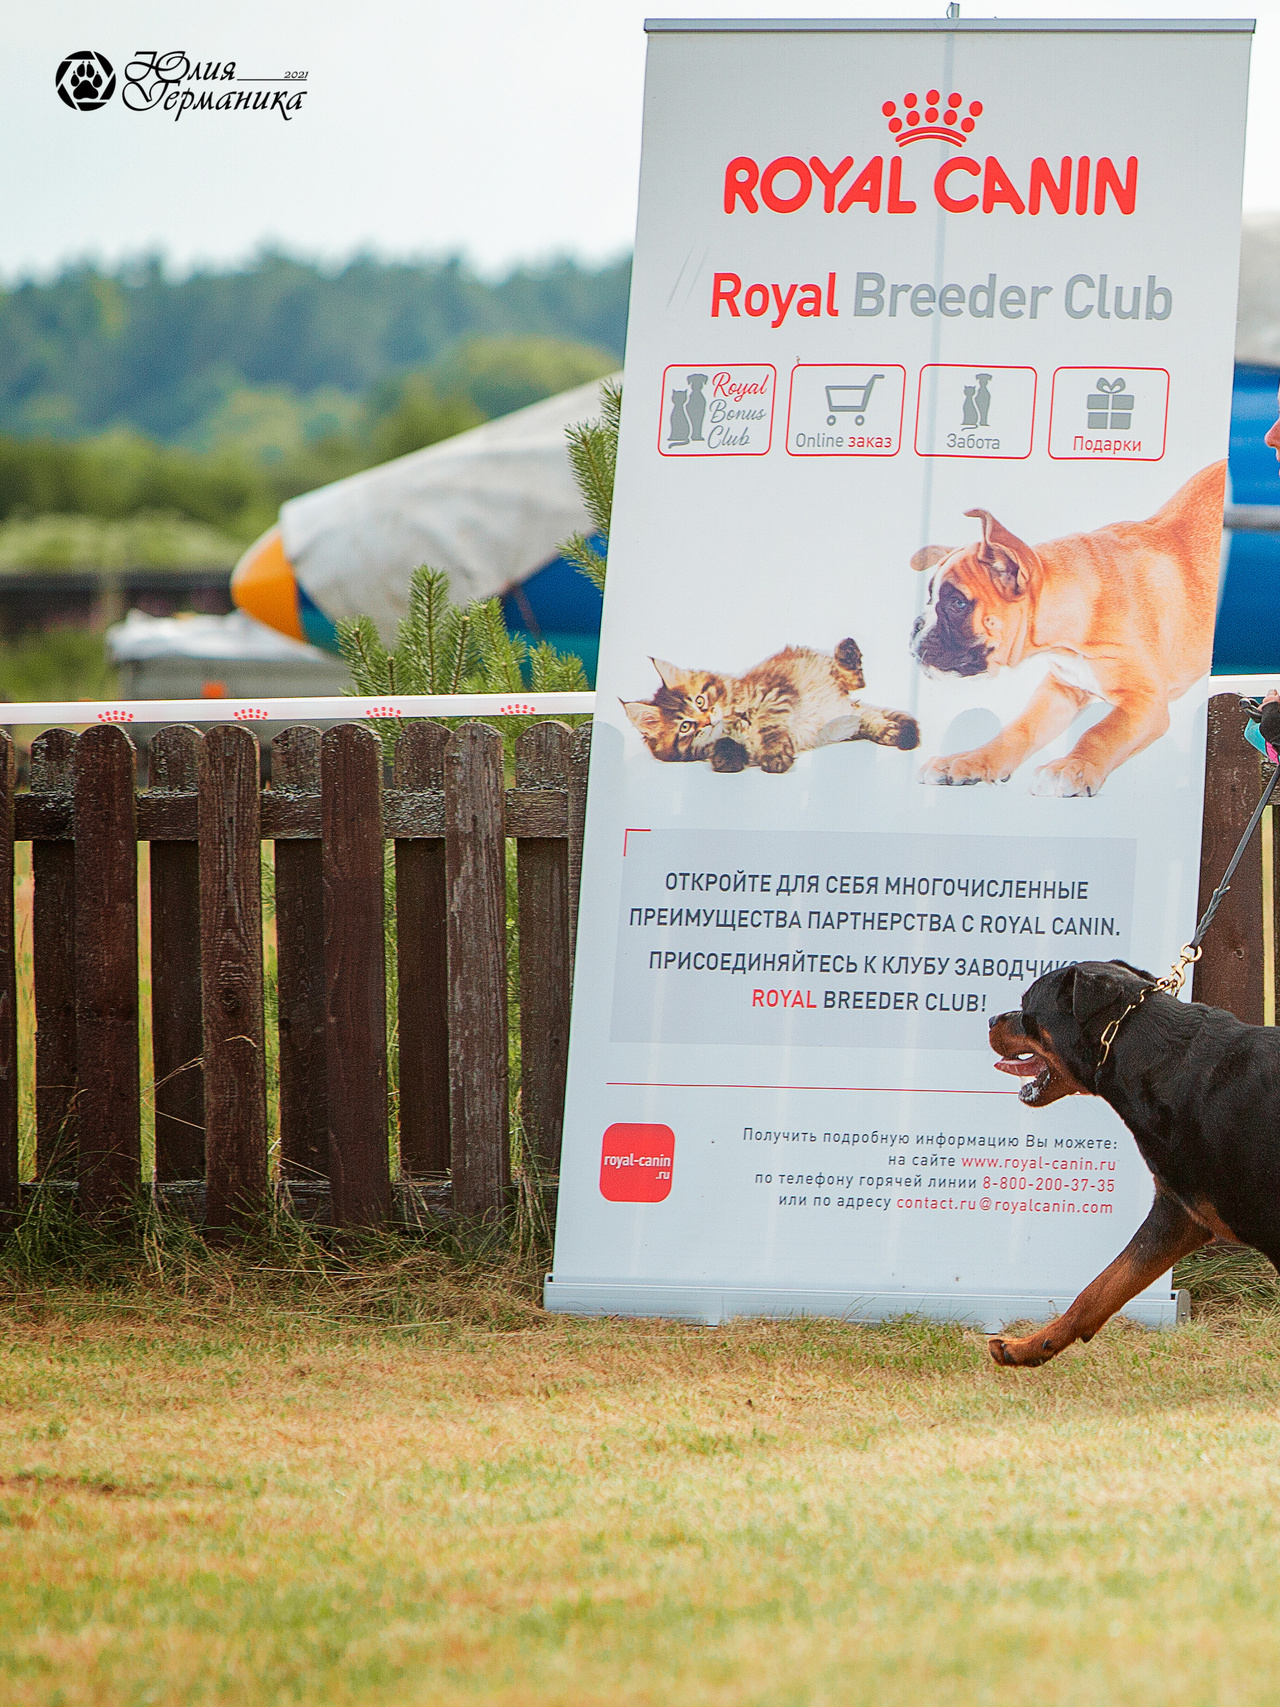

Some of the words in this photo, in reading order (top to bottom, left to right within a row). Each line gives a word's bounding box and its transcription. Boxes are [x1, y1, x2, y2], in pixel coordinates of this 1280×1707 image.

[724, 156, 916, 214] ROYAL
[934, 156, 1138, 215] CANIN
[711, 272, 838, 328] Royal
[854, 272, 1053, 319] Breeder
[1065, 274, 1172, 320] Club
[712, 372, 769, 402] Royal
[709, 399, 767, 423] Bonus
[708, 425, 750, 449] Club
[796, 433, 843, 447] Online
[848, 437, 891, 448] заказ
[947, 434, 999, 449] Забота
[1074, 436, 1141, 454] Подарки
[666, 870, 771, 892] ОТКРОЙТЕ
[776, 875, 819, 896] ДЛЯ
[827, 876, 878, 894] СЕБЯ
[885, 877, 1088, 899] МНОГОЧИСЛЕННЫЕ
[630, 908, 801, 931] ПРЕИМУЩЕСТВА
[808, 911, 955, 932] ПАРТНЕРСТВА
[962, 915, 974, 932] С
[981, 915, 1045, 934] ROYAL
[1053, 917, 1119, 935] CANIN.
[650, 950, 857, 974] ПРИСОЕДИНЯЙТЕСЬ
[865, 956, 877, 973] К
[883, 956, 950, 975] КЛУБУ
[954, 957, 1079, 981] ЗАВОДЧИК
[752, 989, 817, 1008] ROYAL
[824, 991, 918, 1010] BREEDER
[926, 993, 986, 1012] CLUB!
[744, 1128, 816, 1144] Получить
[824, 1131, 909, 1147] подробную
[917, 1133, 1018, 1148] информацию
[1026, 1135, 1047, 1147] Вы
[1055, 1139, 1116, 1149] можете:
[604, 1153, 670, 1168] royal-canin
[889, 1156, 905, 1165] на
[913, 1154, 955, 1166] сайте
[962, 1156, 1115, 1171] www.royal-canin.ru
[656, 1172, 670, 1180] .ru
[755, 1174, 772, 1183] по
[779, 1172, 853, 1188] телефону
[860, 1175, 921, 1189] горячей
[928, 1178, 976, 1188] линии
[983, 1176, 1114, 1192] 8-800-200-37-35
[779, 1196, 806, 1205] или
[814, 1197, 830, 1206] по
[837, 1197, 891, 1211] адресу
[897, 1197, 1112, 1214] contact.ru@royalcanin.com
